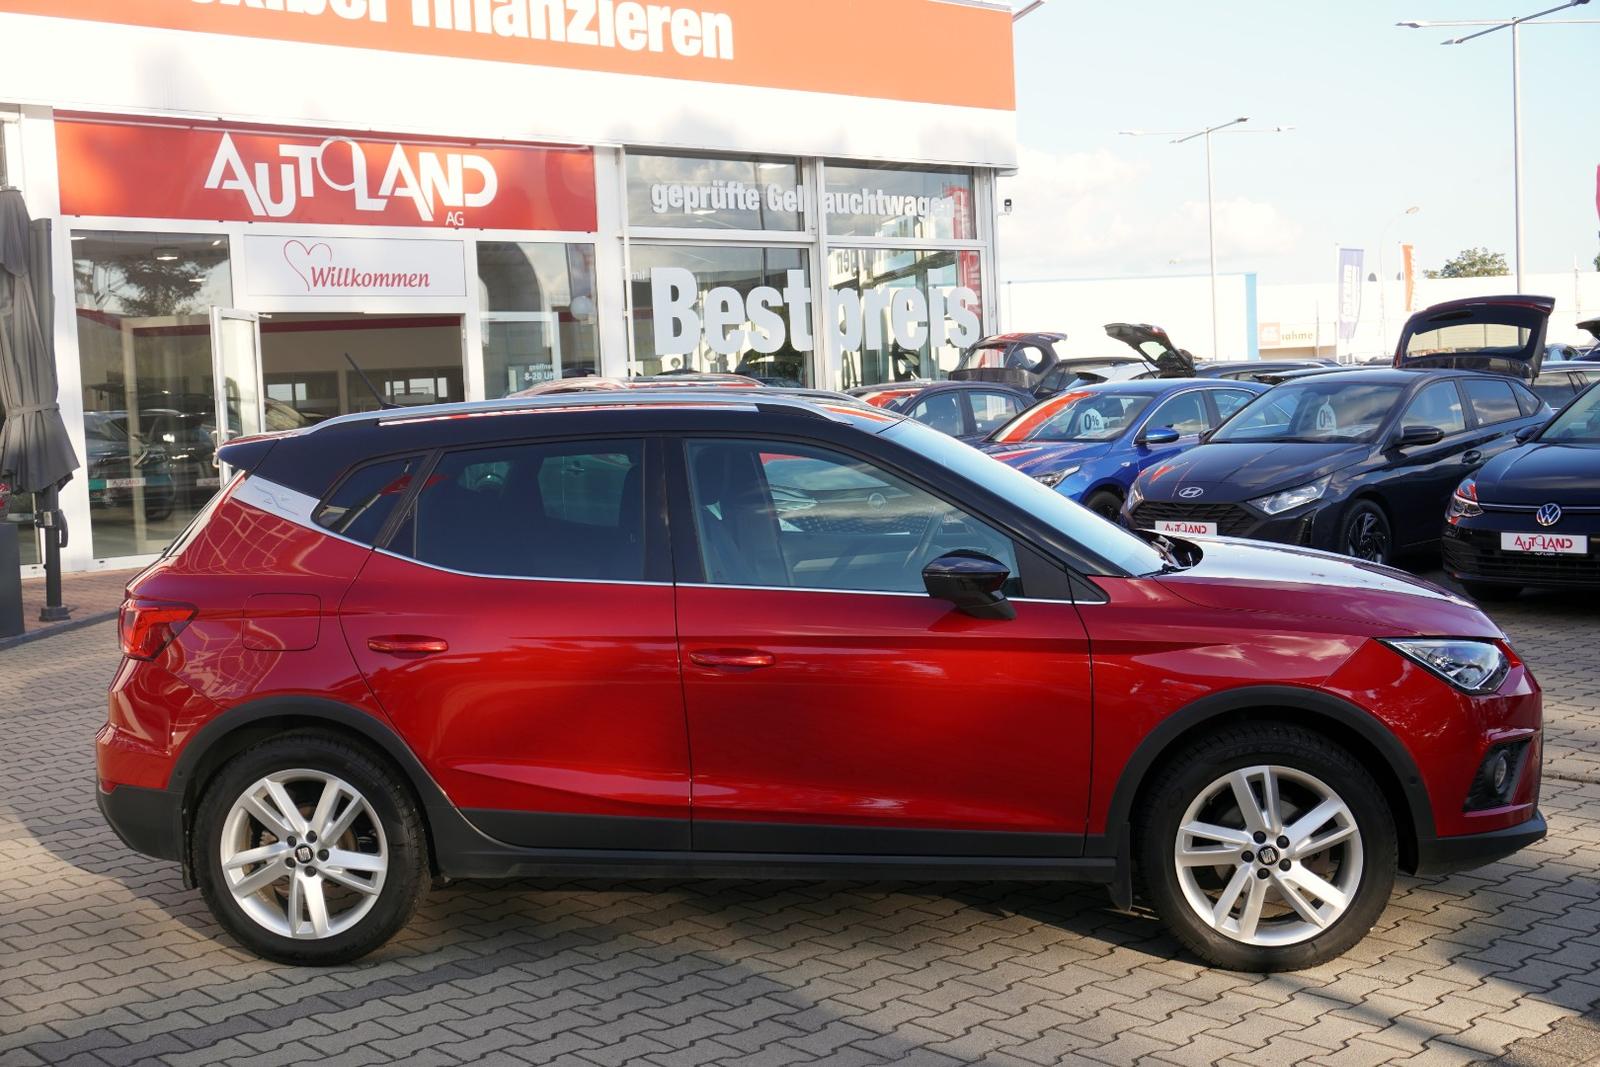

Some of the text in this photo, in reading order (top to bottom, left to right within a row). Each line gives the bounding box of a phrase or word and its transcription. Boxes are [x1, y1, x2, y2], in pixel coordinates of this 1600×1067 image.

[651, 180, 956, 221] geprüfte Geauchtwagen
[445, 211, 465, 226] AG
[310, 266, 431, 288] Willkommen
[1084, 413, 1100, 430] 0%
[1514, 534, 1573, 551] AUTOLAND
